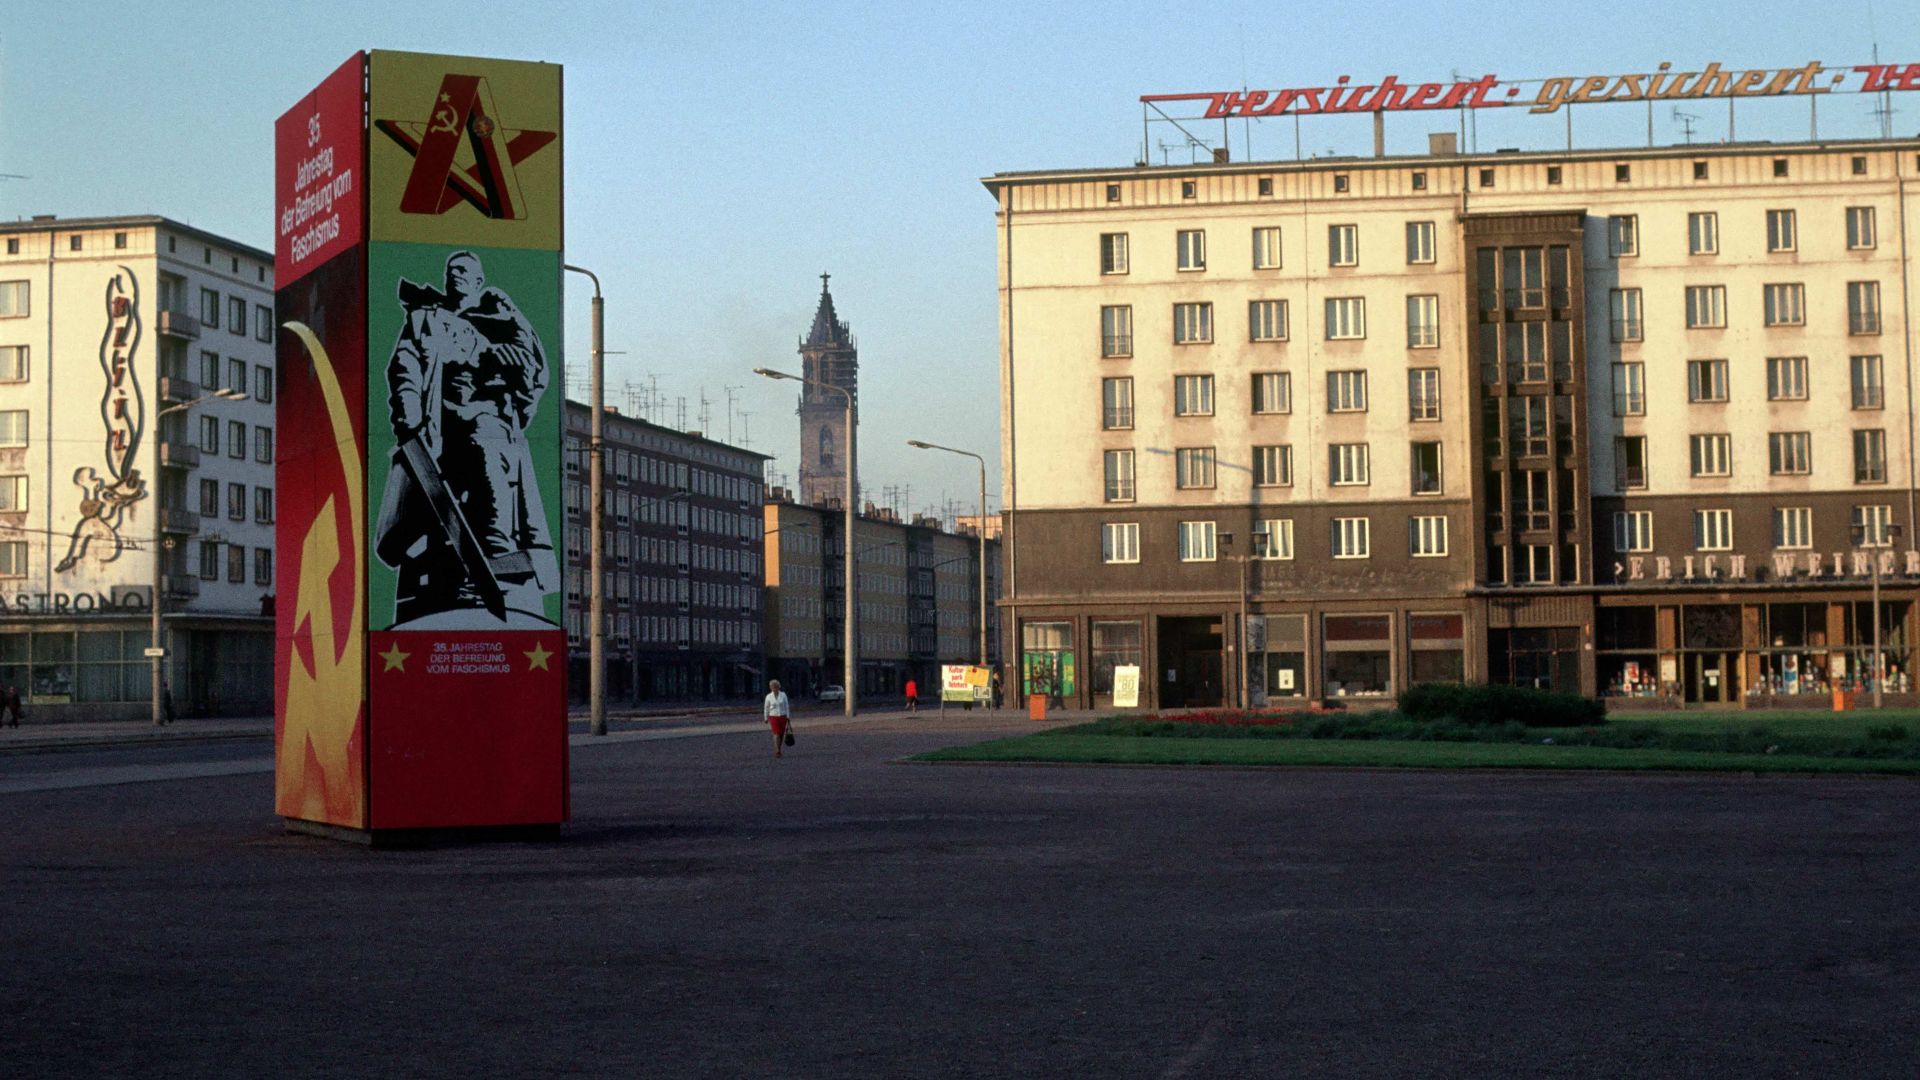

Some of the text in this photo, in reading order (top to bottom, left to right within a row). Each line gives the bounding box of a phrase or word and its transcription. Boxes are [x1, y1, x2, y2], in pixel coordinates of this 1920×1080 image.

[295, 146, 333, 193] Jahrestag
[281, 168, 352, 237] der Befreiung vom
[291, 213, 340, 265] Faschismus
[1630, 554, 1746, 580] ERICH
[430, 653, 506, 663] DER BEFREIUNG
[448, 642, 504, 652] JAHRESTAG
[426, 663, 510, 673] VOM FASCHISMUS
